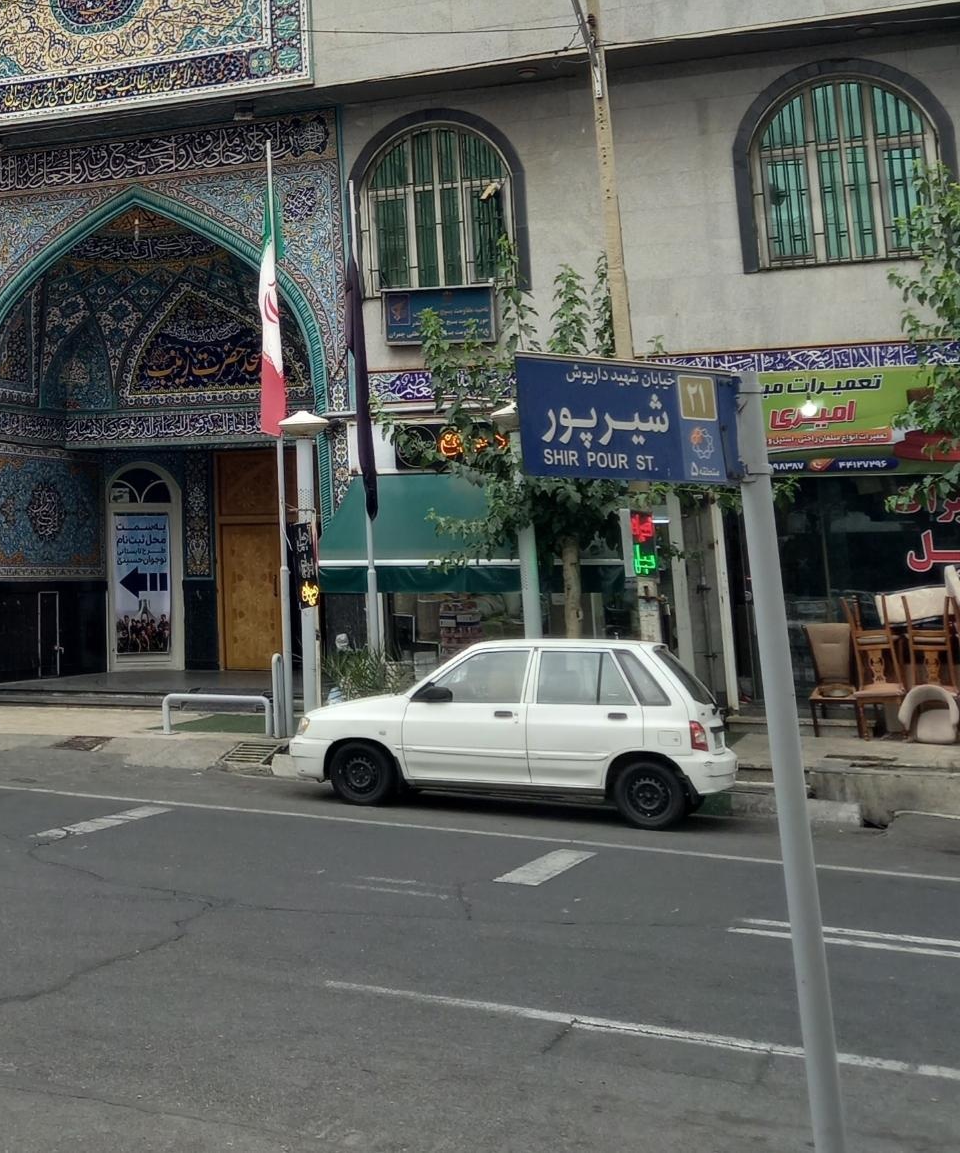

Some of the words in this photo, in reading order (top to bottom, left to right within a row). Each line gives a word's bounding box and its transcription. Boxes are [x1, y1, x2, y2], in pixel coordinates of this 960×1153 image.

[565, 364, 609, 385] داریوش
[609, 367, 640, 386] شهید
[641, 371, 676, 390] خیابان
[762, 382, 784, 399] مب
[786, 374, 883, 396] تعمیرات
[686, 382, 707, 414] ۲۱
[541, 393, 670, 449] شیرپور
[769, 399, 857, 432] امیری
[859, 433, 888, 442] تعمیرات
[543, 448, 580, 467] SHIR
[587, 451, 630, 469] POUR
[635, 455, 659, 472] ST.
[690, 461, 700, 477] ۵
[699, 467, 721, 477] منطقه
[145, 534, 167, 546] محل
